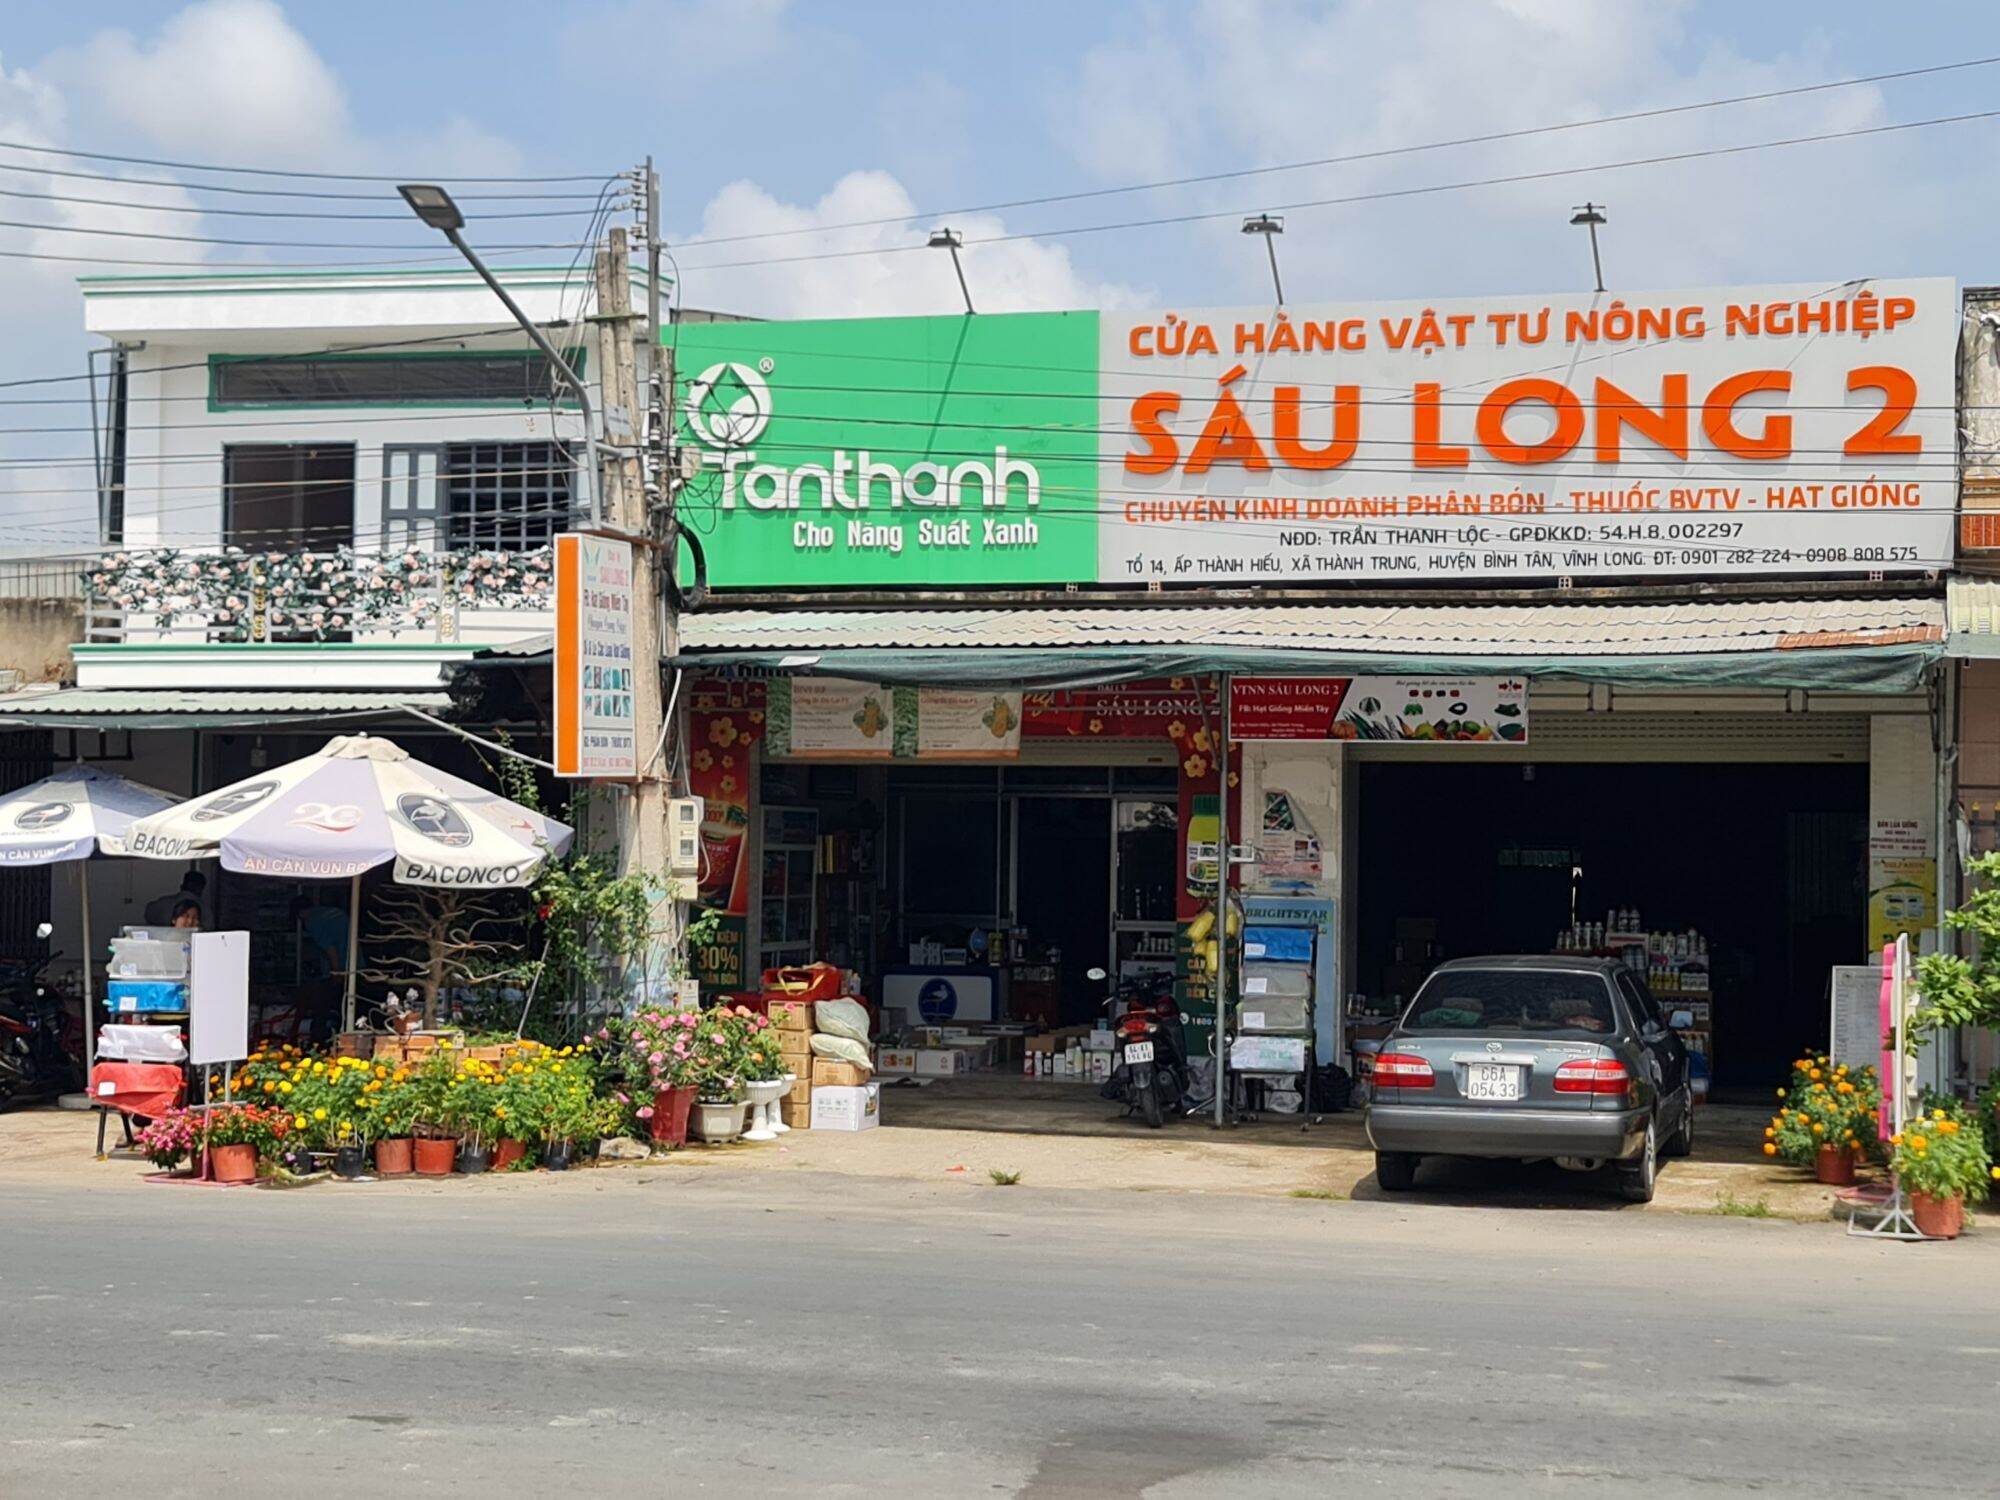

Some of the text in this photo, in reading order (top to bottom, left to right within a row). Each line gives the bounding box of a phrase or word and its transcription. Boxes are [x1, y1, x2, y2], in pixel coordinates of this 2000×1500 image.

[1129, 290, 1916, 356] CỬA HÀNG VẬT TƯ NÔNG NGHIỆP
[1124, 364, 1922, 475] SÁU LONG 2
[702, 446, 1040, 510] Tanthanh
[1125, 496, 1226, 523] CHUYÊN
[1234, 498, 1297, 521] KINH
[1307, 496, 1397, 519] DOANH
[1407, 490, 1481, 516] PHÂN
[1490, 486, 1544, 515] BÓN
[1570, 481, 1660, 513] THUỐC
[1670, 488, 1741, 511] BVTV
[1831, 474, 1920, 508] GIỐNG
[793, 517, 1038, 552] Cho Năng Suất Xanh
[1280, 531, 1321, 546] NĐD:
[1329, 524, 1377, 545] TRẦN
[1386, 528, 1447, 544] THANH
[1458, 525, 1490, 546] LỘC
[1150, 560, 1167, 576] 14,
[1174, 554, 1192, 573] ẤP
[1197, 555, 1243, 573] THÀNH
[1250, 553, 1283, 574] HIẾU,
[1292, 554, 1311, 572] XÃ
[1316, 553, 1363, 571] THÀNH
[1371, 556, 1420, 572] TRUNG,
[1429, 552, 1476, 572] HUYỆN
[1484, 550, 1517, 568] BÌNH
[1524, 551, 1556, 569] TÂN,
[1563, 549, 1597, 567] VĨNH
[1654, 551, 1676, 566] ĐT:
[1681, 550, 1717, 565] 0901
[1726, 549, 1754, 564] 282
[1762, 548, 1790, 563] 224
[1806, 547, 1847, 562] 0908
[1854, 547, 1884, 561] 808
[1890, 546, 1918, 561] 575
[1232, 681, 1340, 695] VTNN SÁU LONG 2
[1096, 696, 1138, 716] SÁU
[1144, 699, 1202, 716] LONG
[310, 862, 341, 874] VUN
[406, 863, 520, 884] BACONCO
[698, 947, 738, 970] 30%
